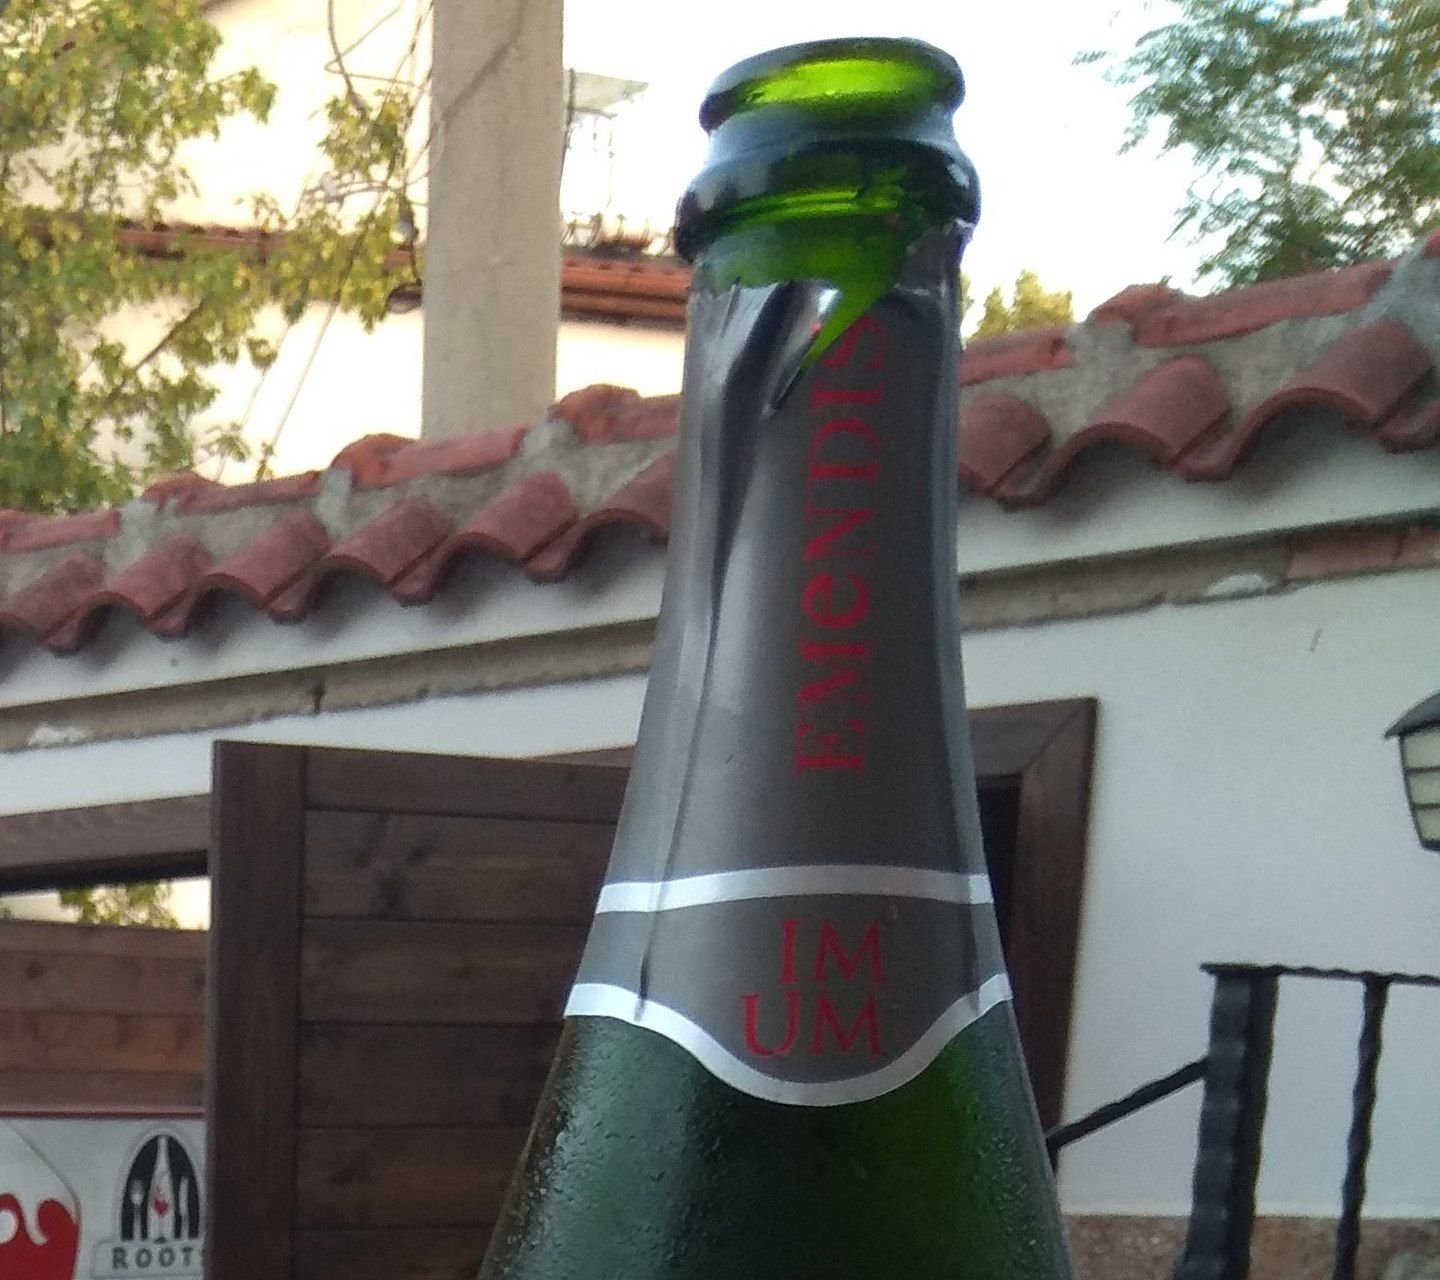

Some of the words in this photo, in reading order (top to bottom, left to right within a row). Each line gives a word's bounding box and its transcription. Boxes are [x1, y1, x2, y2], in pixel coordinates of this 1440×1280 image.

[779, 916, 886, 984] IM
[741, 992, 884, 1056] UM
[111, 1246, 205, 1270] ROOT
